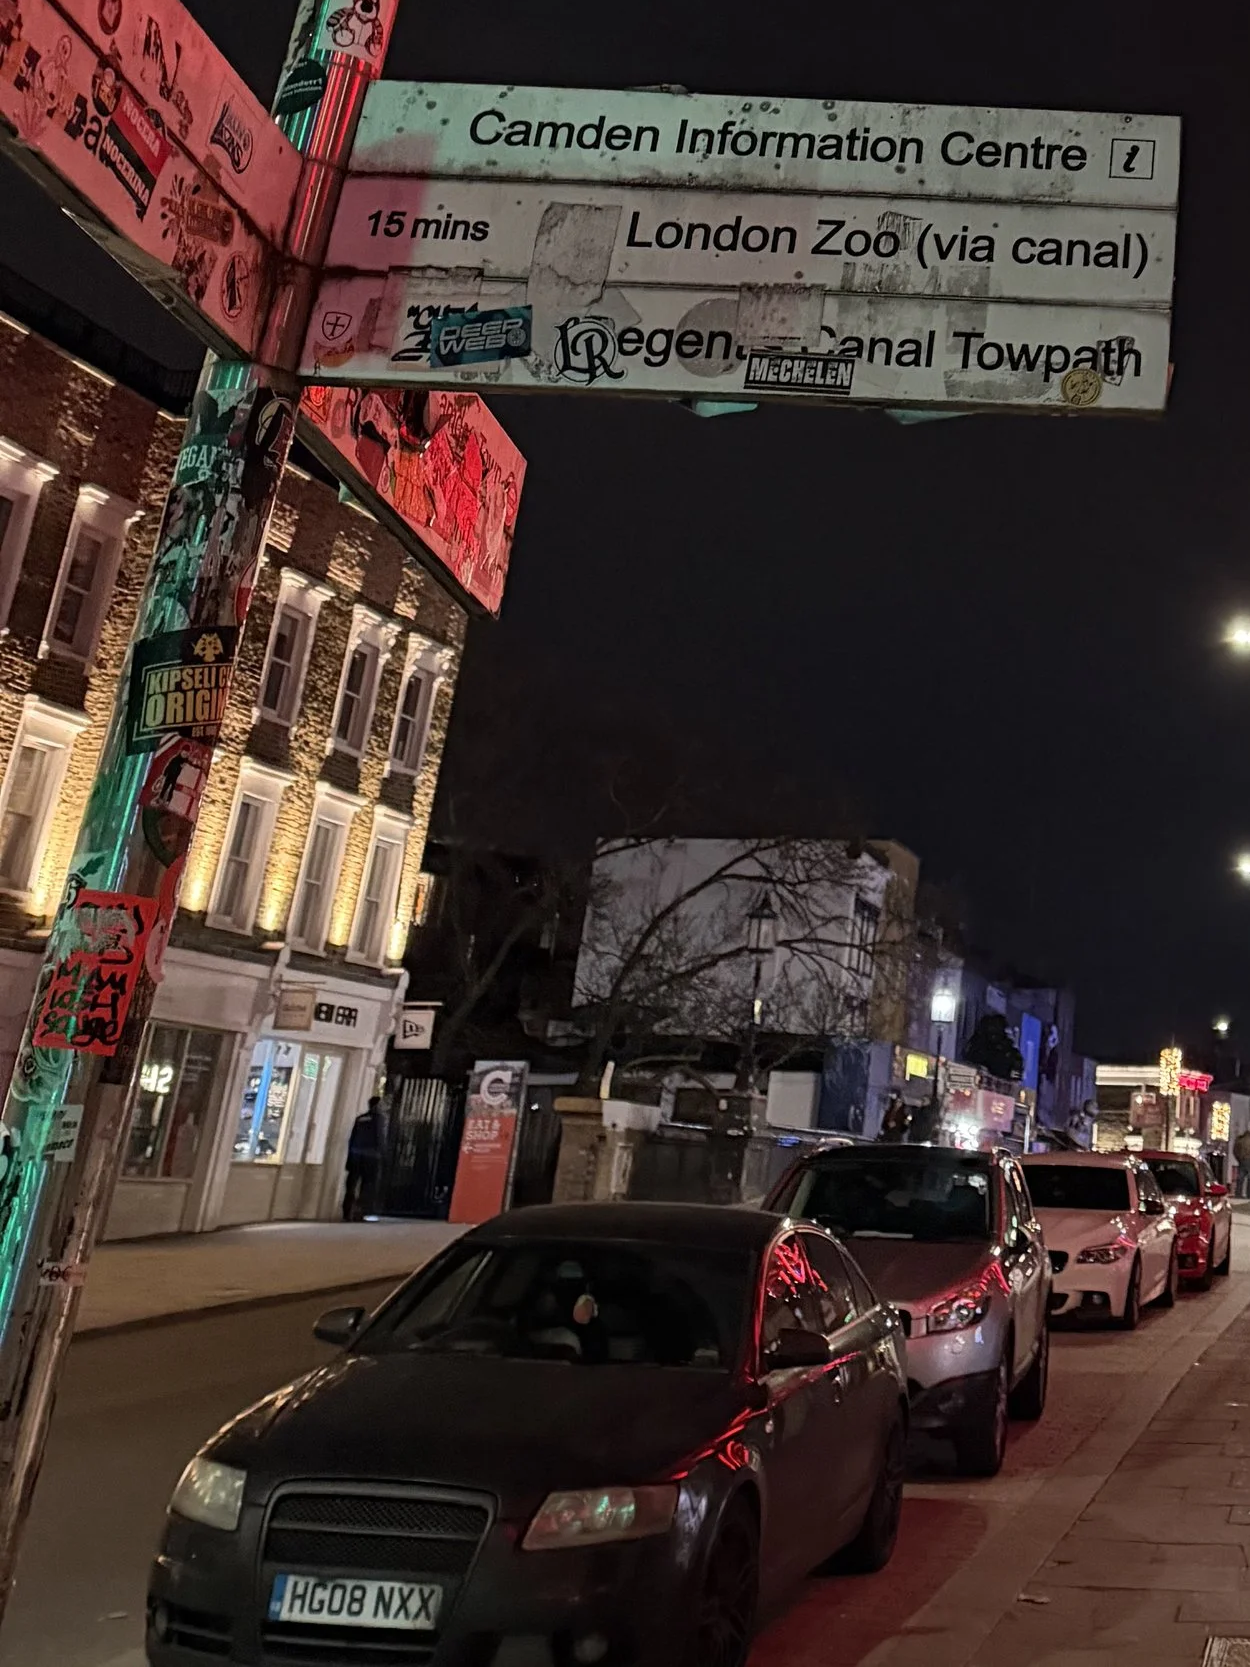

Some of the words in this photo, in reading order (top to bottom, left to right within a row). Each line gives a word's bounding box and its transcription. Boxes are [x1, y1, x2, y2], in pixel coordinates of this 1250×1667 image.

[122, 101, 160, 158] NOCERA
[470, 109, 659, 152] Camden
[675, 119, 923, 165] Information
[940, 131, 1087, 172] Centre
[367, 210, 404, 238] 15
[411, 213, 490, 241] mins
[626, 211, 798, 254] London
[811, 219, 900, 258] Zoo
[917, 223, 995, 269] (via
[1012, 232, 1148, 279] canal)
[438, 335, 506, 356] WEB
[440, 319, 524, 340] DEEP
[748, 357, 852, 386] MECHELEN
[952, 331, 1142, 383] Towpath
[148, 666, 217, 695] KIPSELI
[288, 1581, 367, 1616] HG08
[373, 1586, 436, 1621] NXX
